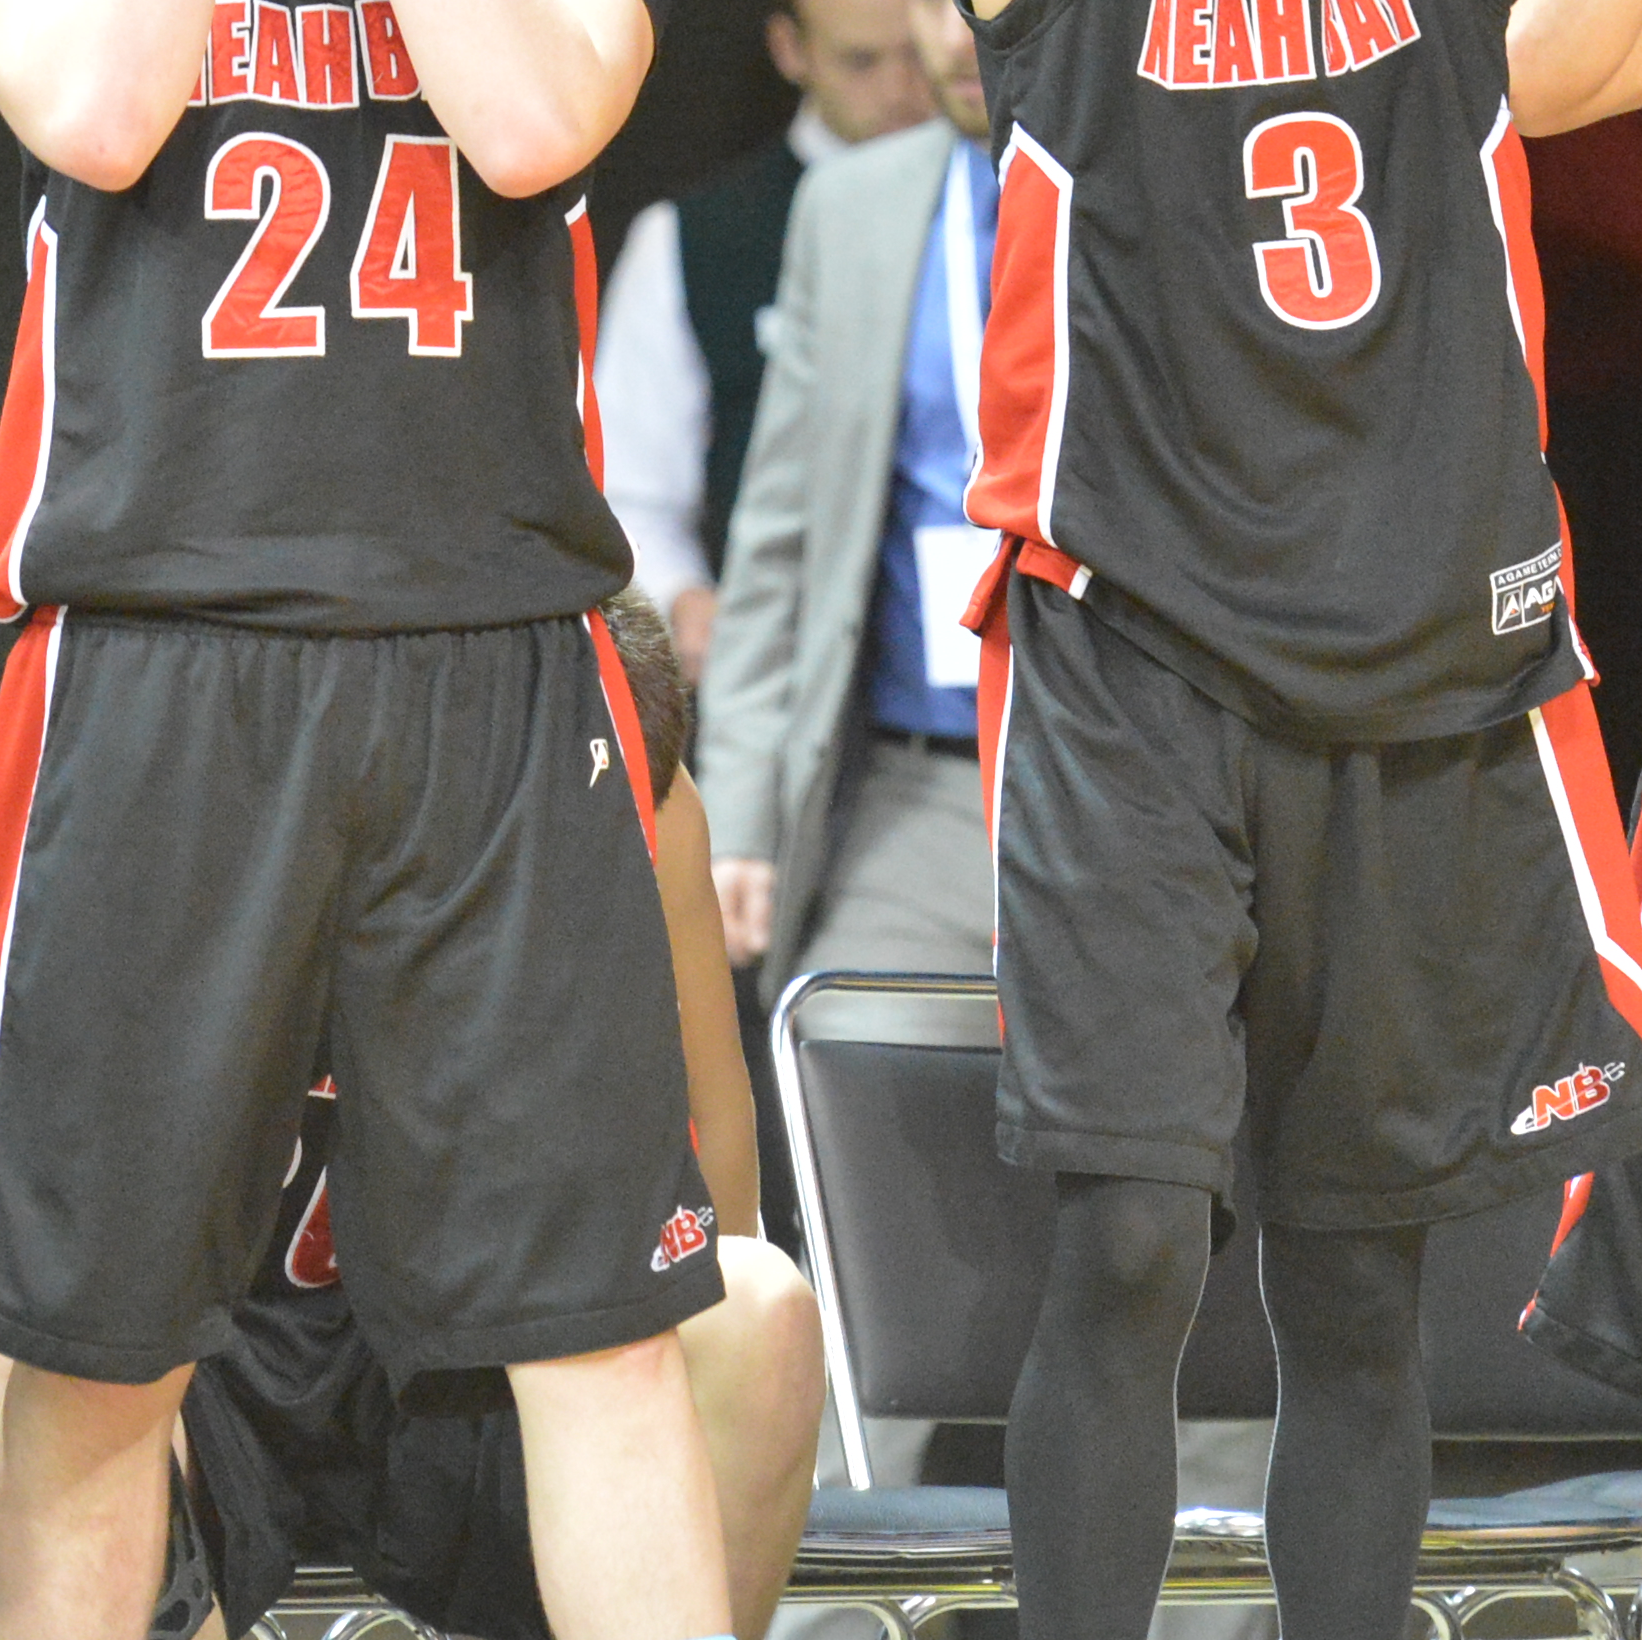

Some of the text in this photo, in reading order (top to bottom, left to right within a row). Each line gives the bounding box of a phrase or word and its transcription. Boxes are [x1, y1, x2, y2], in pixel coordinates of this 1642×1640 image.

[202, 133, 473, 358] 24
[1244, 111, 1380, 330] 3
[1531, 1063, 1612, 1129] NB
[658, 1207, 708, 1265] NB
